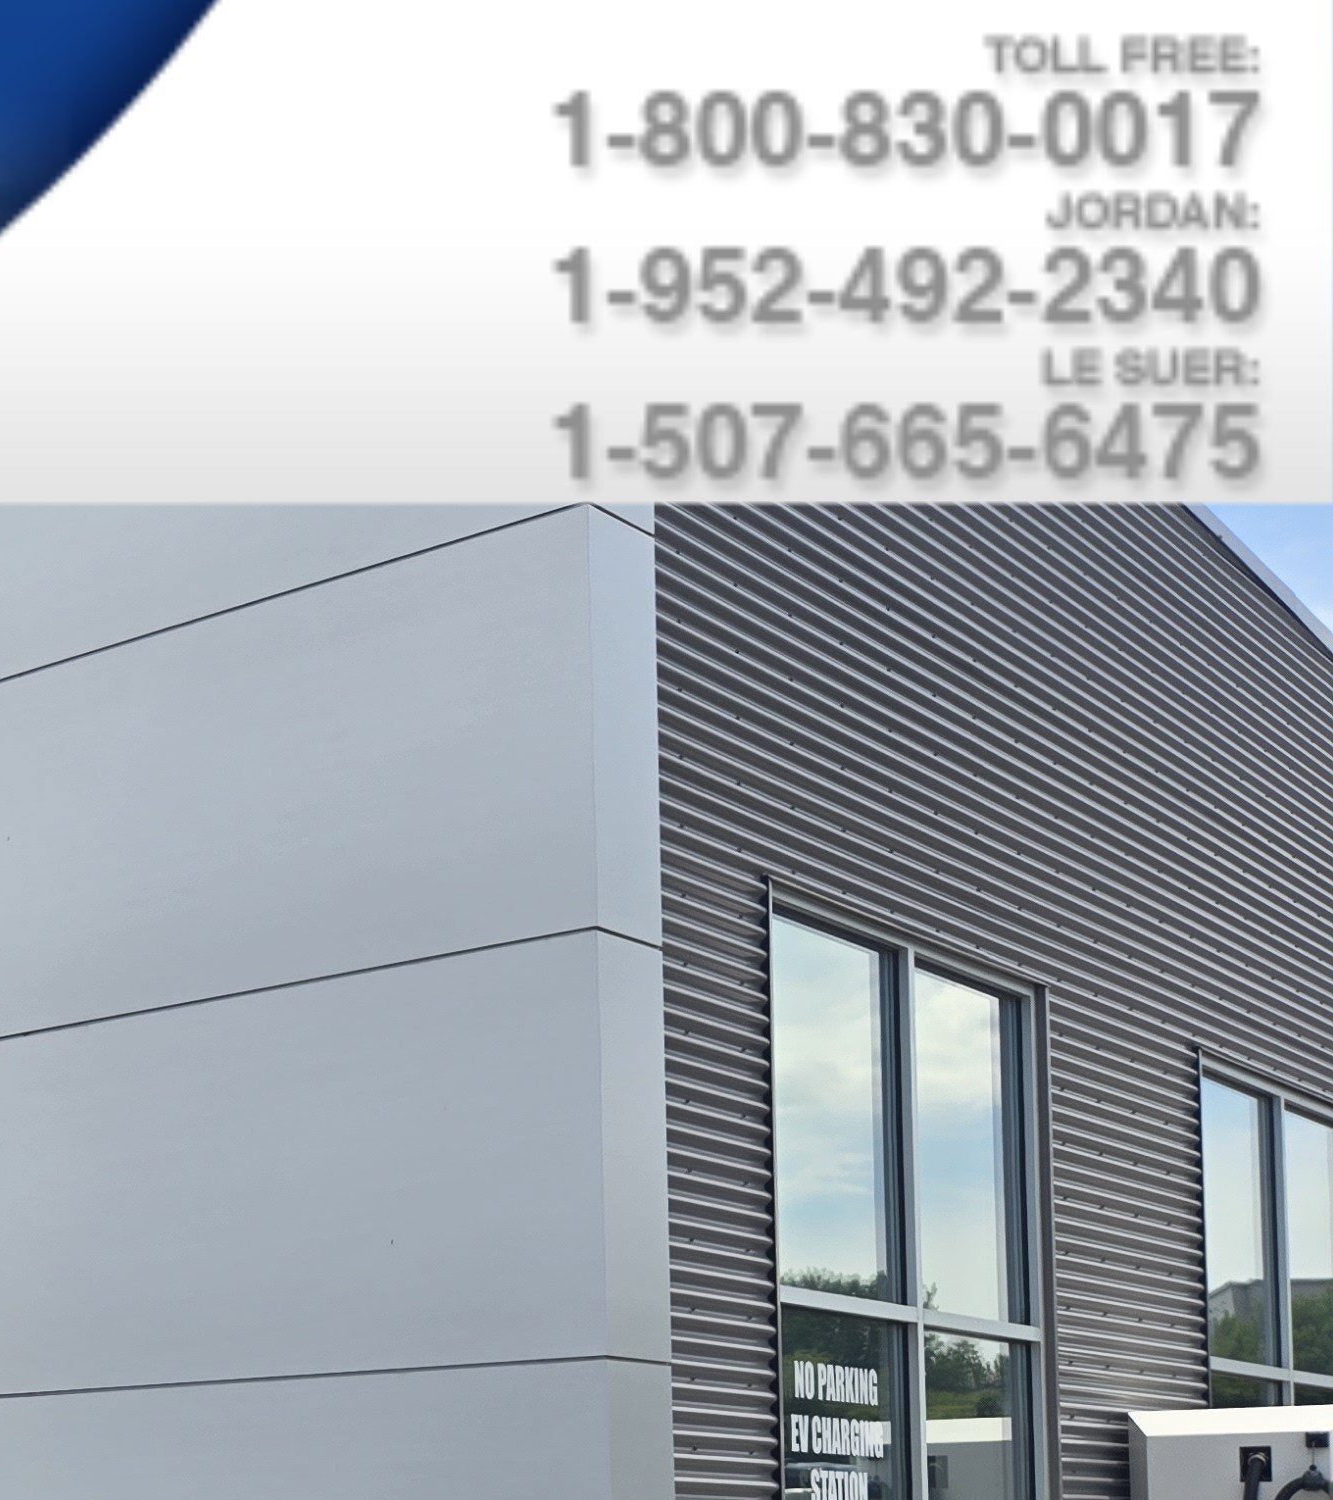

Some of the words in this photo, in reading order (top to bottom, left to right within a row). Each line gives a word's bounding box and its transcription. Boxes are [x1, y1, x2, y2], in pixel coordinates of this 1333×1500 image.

[793, 1360, 815, 1399] NO
[817, 1363, 878, 1406] PARKING
[791, 1414, 809, 1453] EV
[811, 1415, 884, 1459] CHARGING
